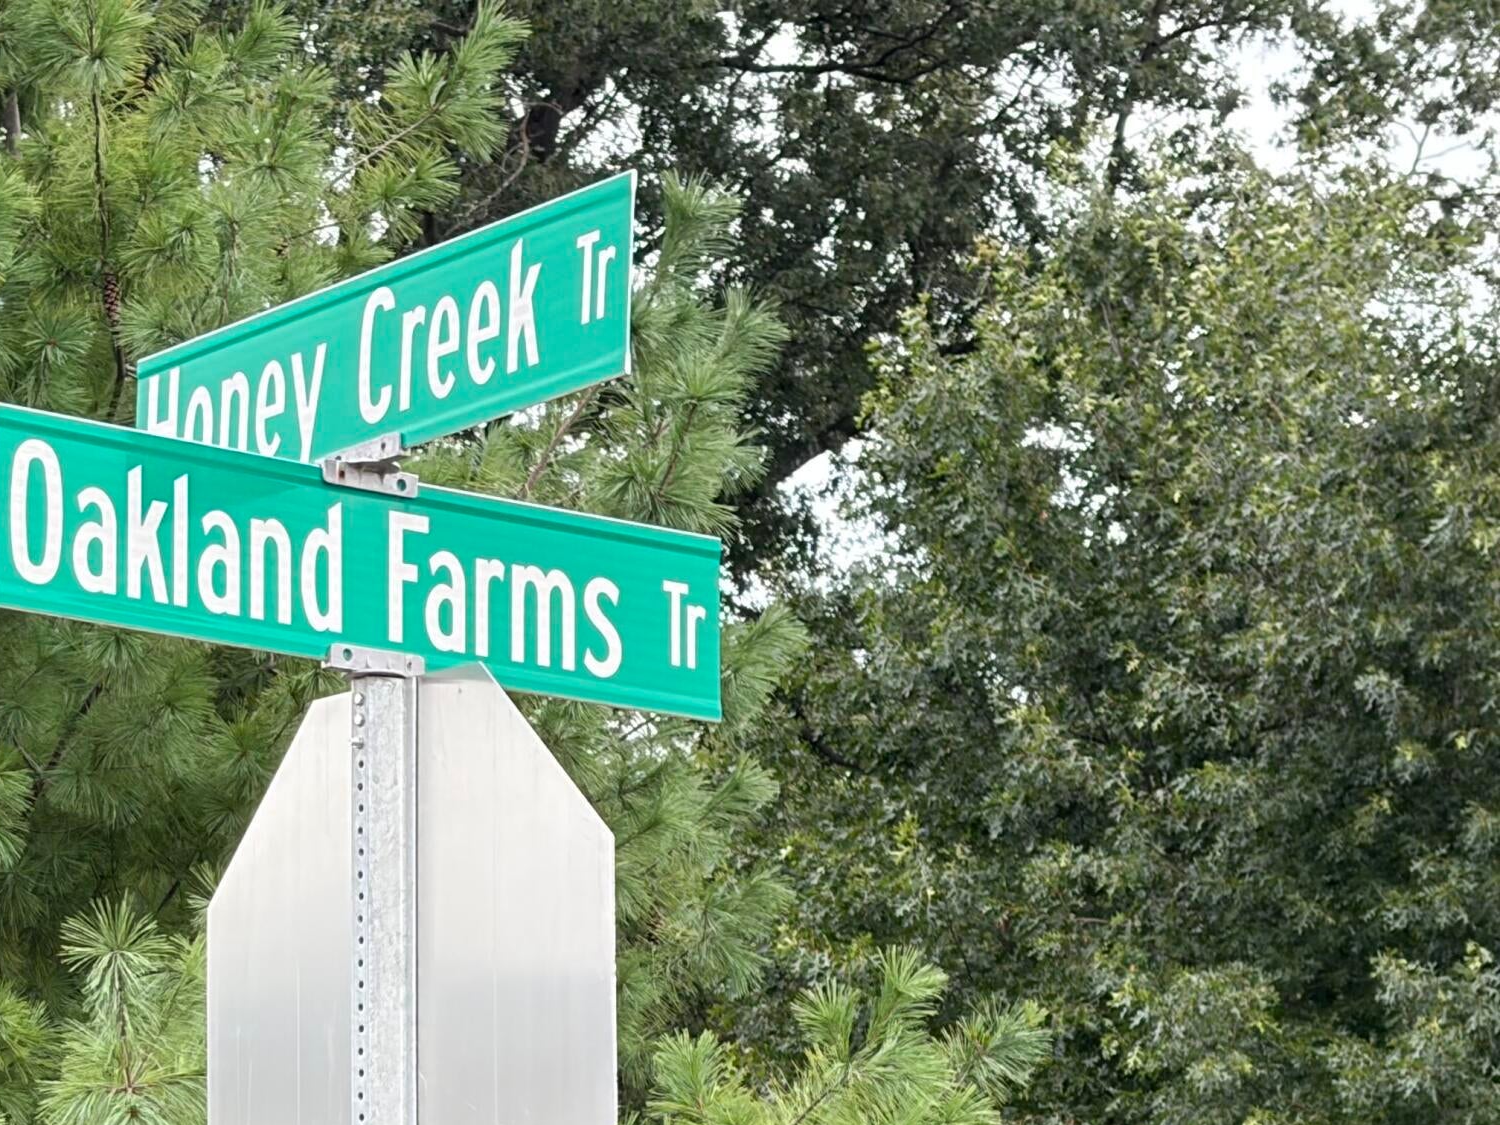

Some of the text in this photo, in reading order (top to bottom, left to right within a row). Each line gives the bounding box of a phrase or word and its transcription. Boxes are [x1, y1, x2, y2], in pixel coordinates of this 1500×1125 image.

[146, 229, 617, 464] Honey Creek Tr
[10, 438, 706, 679] Oakland Farms Tr
